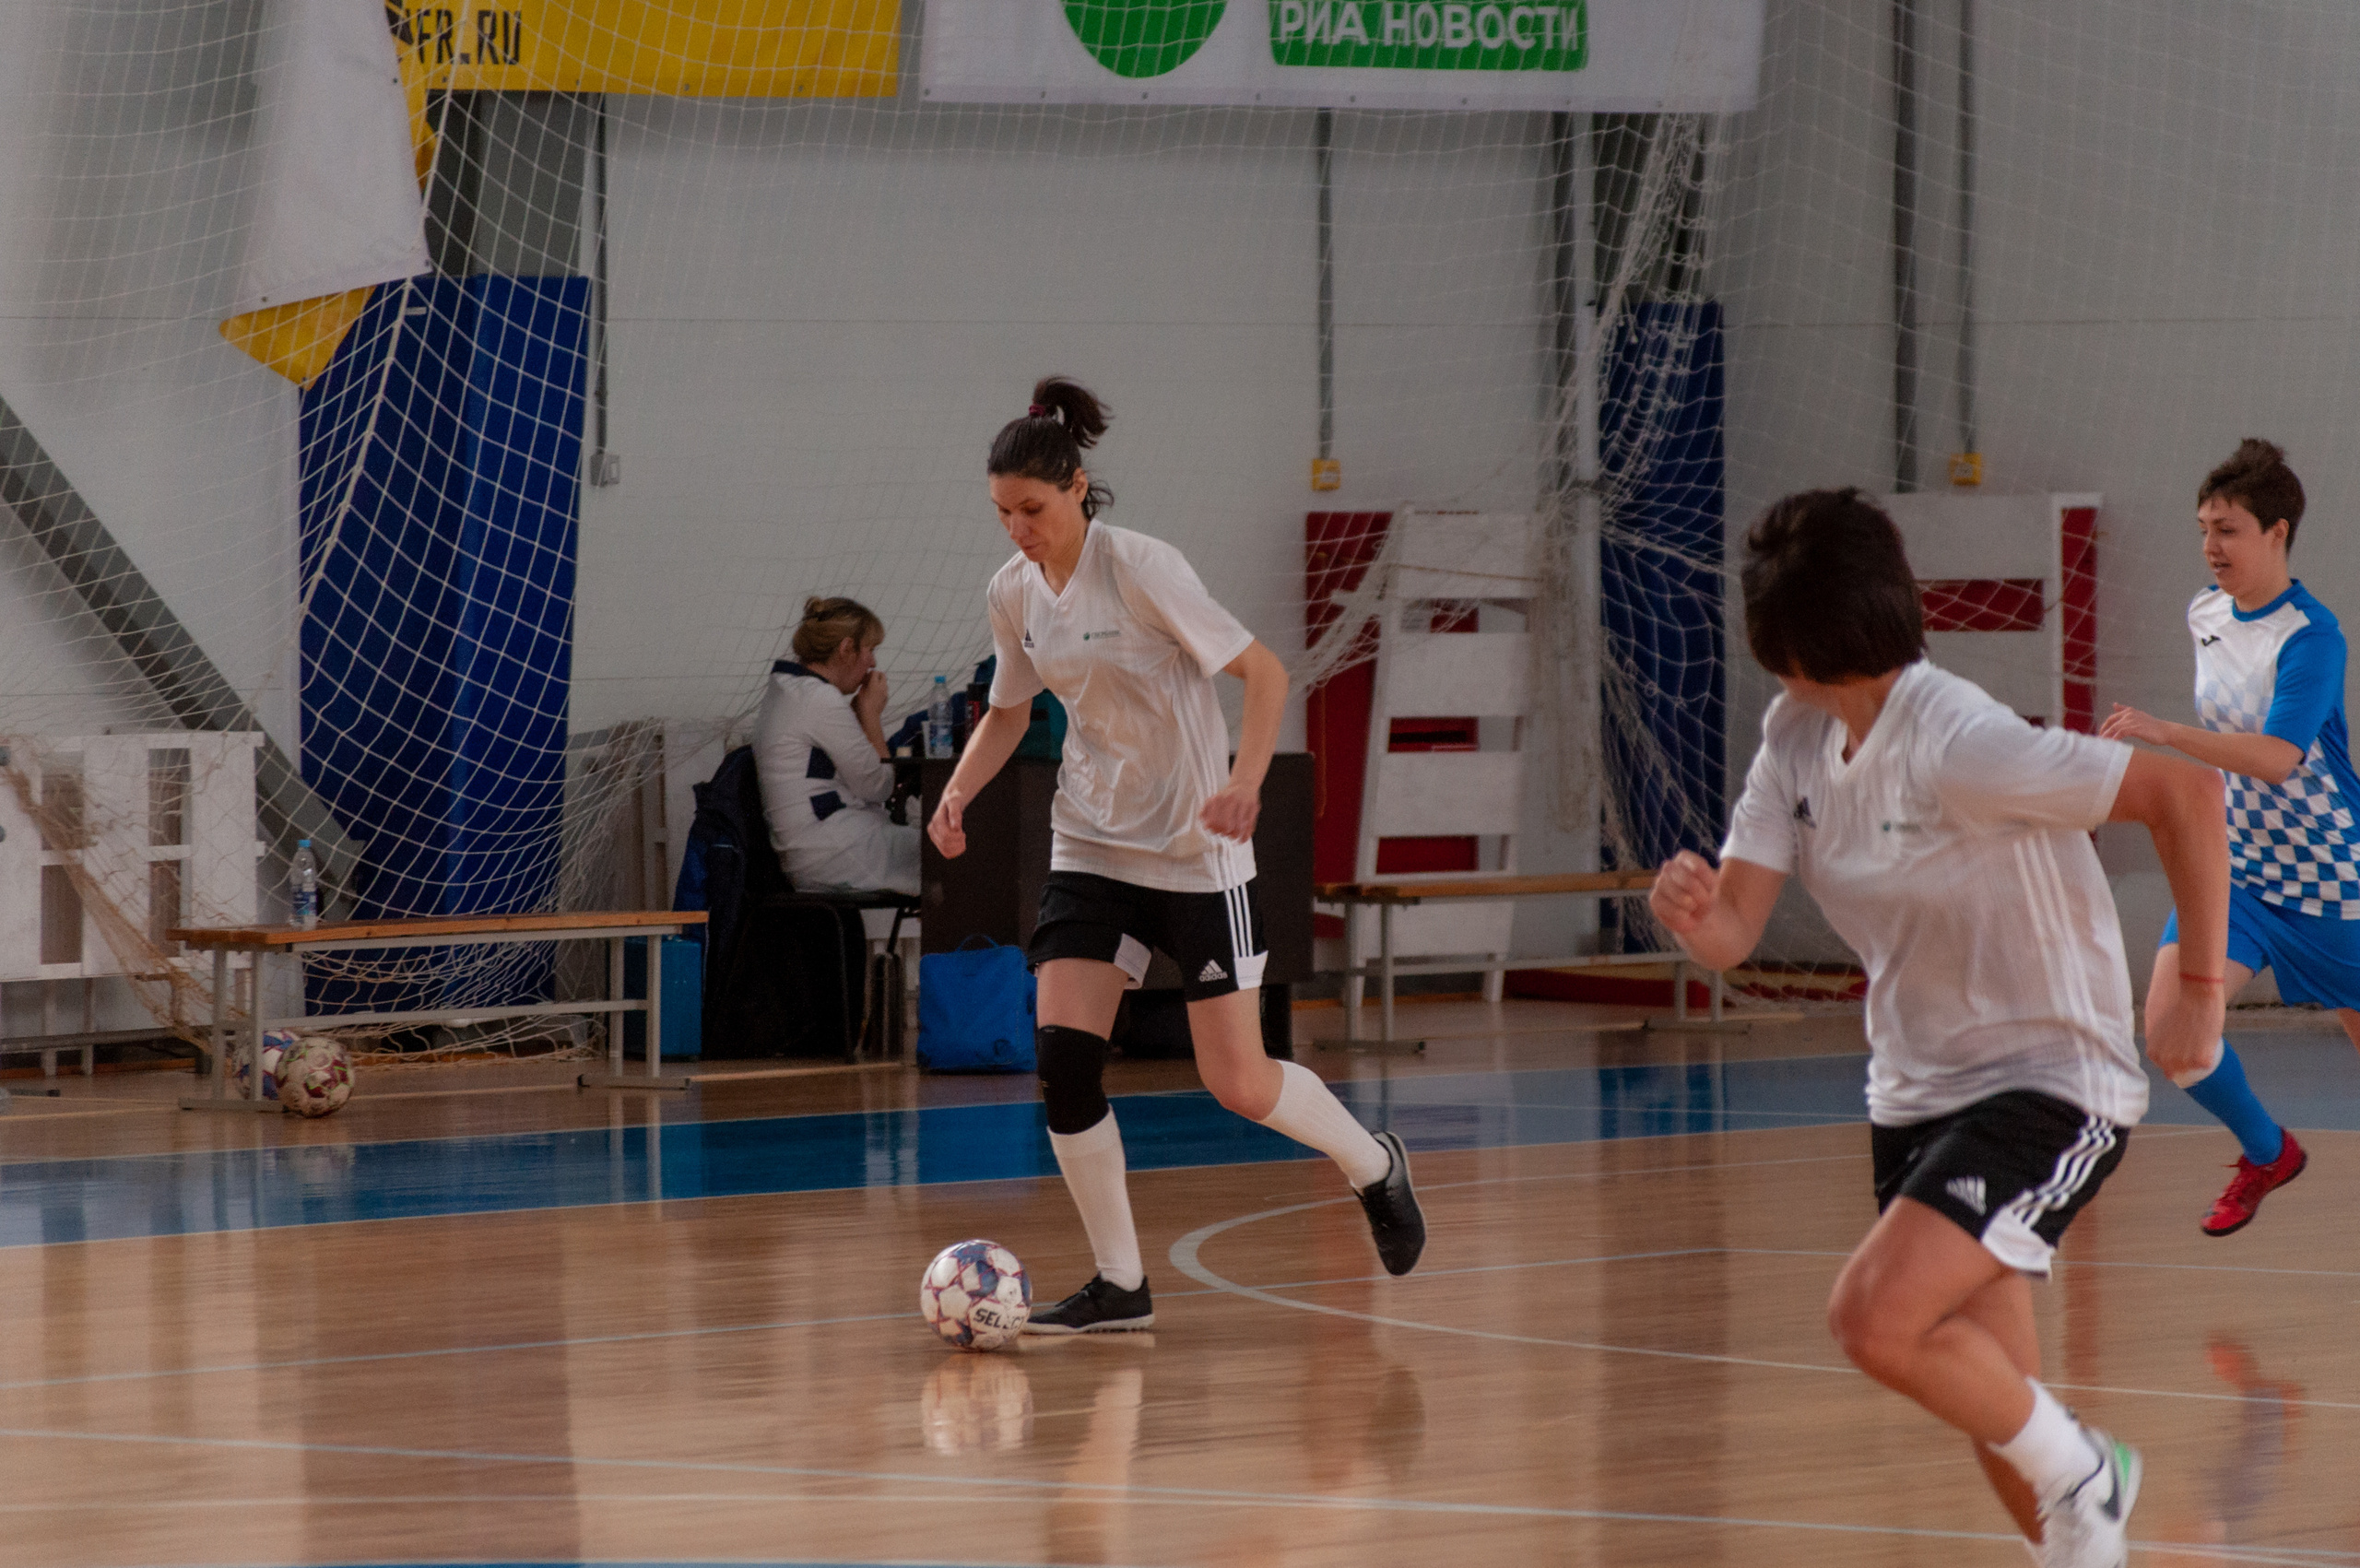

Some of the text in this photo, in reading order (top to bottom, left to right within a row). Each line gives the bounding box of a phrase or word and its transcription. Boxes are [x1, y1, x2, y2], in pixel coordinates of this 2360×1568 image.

[406, 8, 522, 65] FR.RU
[1280, 1, 1578, 51] РИА НОВОСТИ
